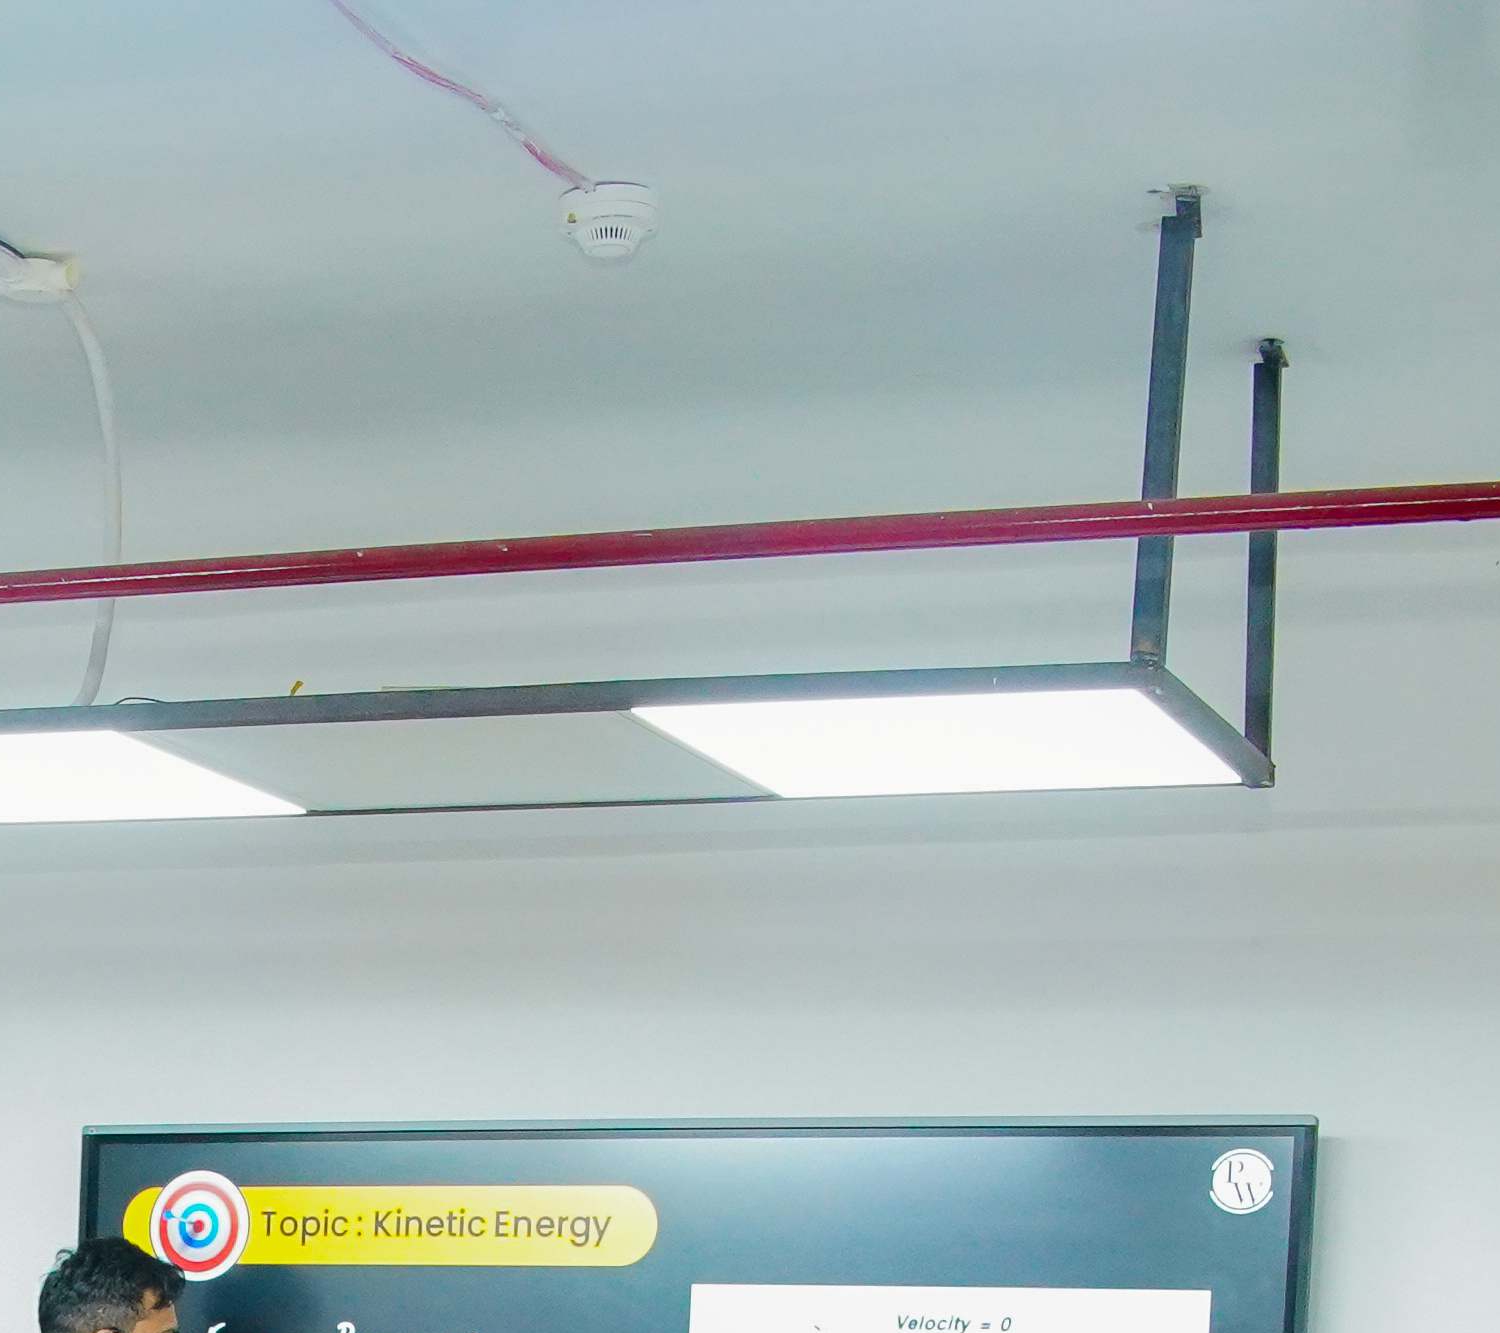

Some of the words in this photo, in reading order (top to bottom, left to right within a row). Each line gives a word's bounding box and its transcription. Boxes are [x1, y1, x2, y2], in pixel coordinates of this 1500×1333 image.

[263, 1210, 348, 1245] Topic
[374, 1209, 486, 1238] Kinetic
[495, 1210, 612, 1247] Energy
